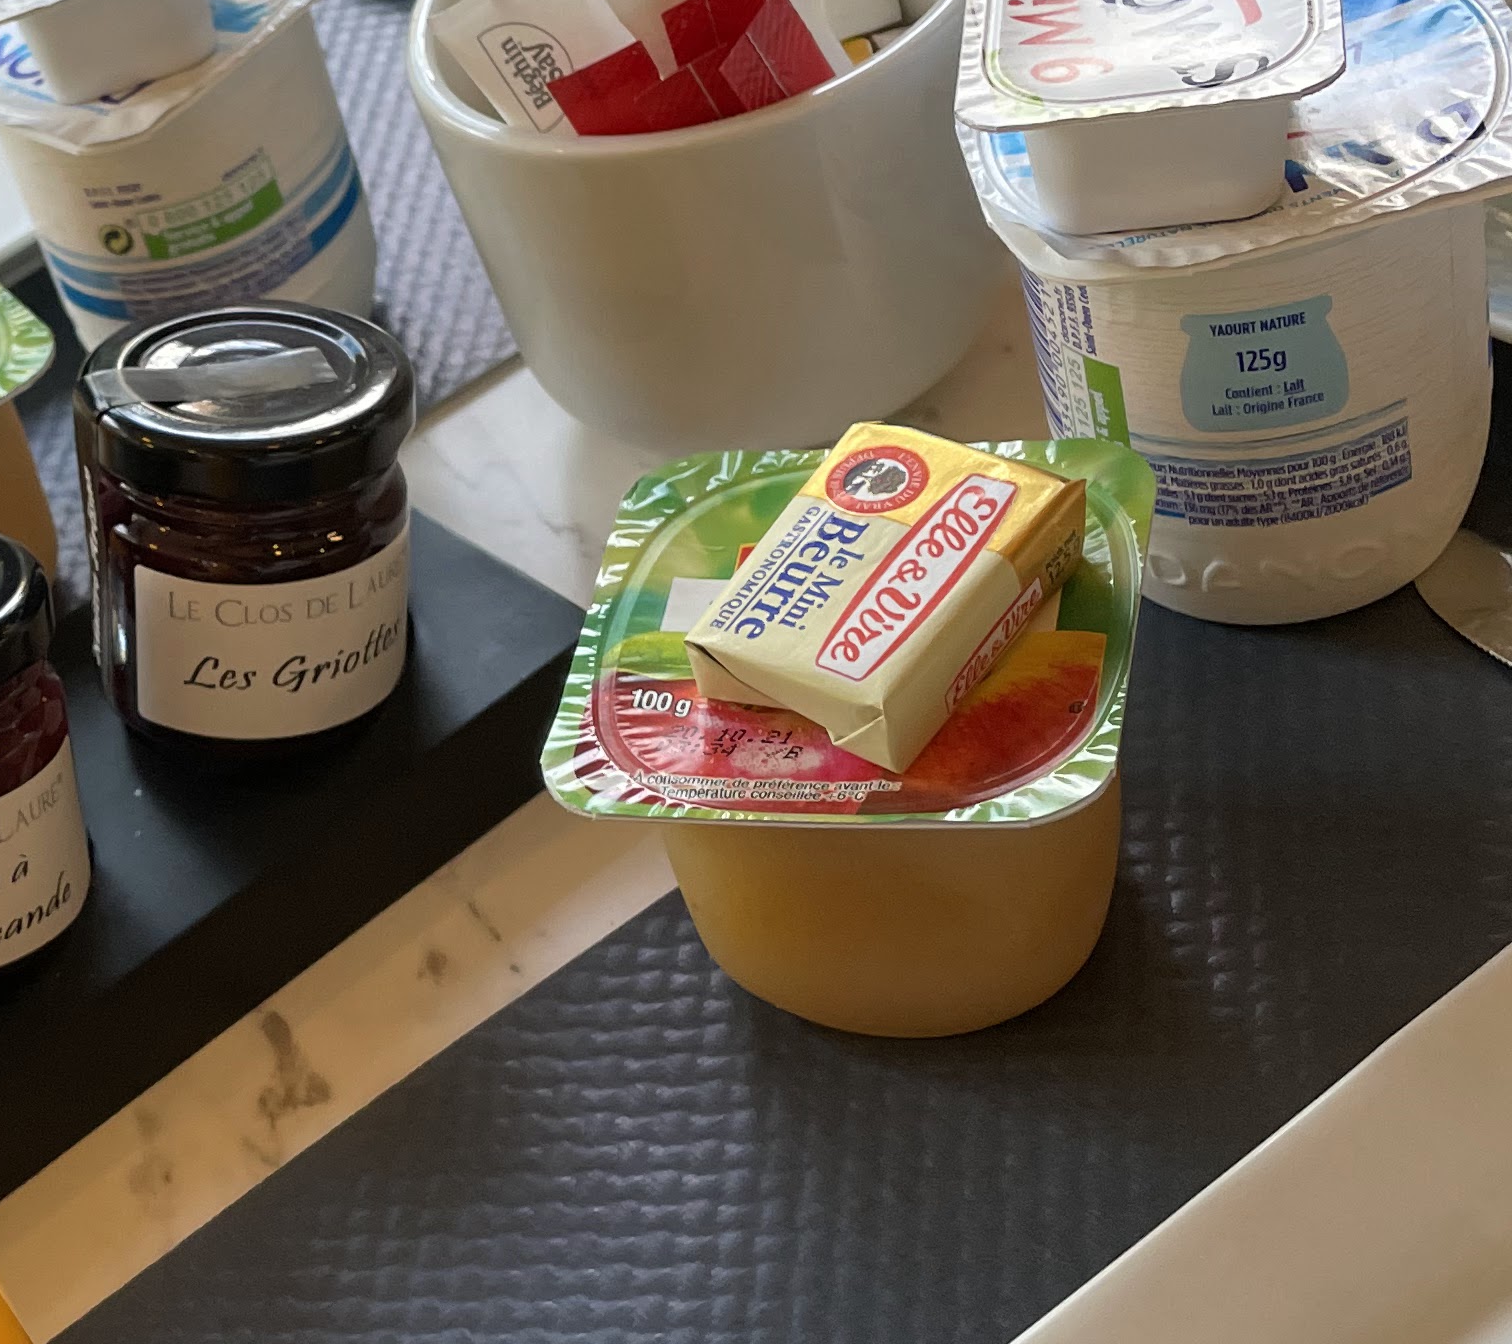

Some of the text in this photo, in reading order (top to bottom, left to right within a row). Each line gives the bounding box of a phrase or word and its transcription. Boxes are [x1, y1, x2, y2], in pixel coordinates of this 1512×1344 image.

[501, 36, 553, 109] Béghin
[1030, 56, 1113, 84] 9
[1209, 311, 1306, 337] YAOURT NATURE
[1235, 348, 1287, 373] 125g
[1212, 391, 1325, 416] Lait Origine France
[1225, 378, 1306, 400] Contient Lait
[709, 505, 822, 630] GASTRONOMIQUE
[733, 510, 870, 641] Beurre
[830, 485, 998, 663] Elle & Vire
[777, 545, 866, 632] le Mini
[169, 591, 201, 620] LE
[215, 599, 292, 627] CLOS
[184, 618, 402, 693] Les Griottes
[631, 687, 692, 718] 100 g
[647, 773, 729, 788] consommer
[733, 778, 751, 789] de
[753, 777, 831, 792] préférence
[834, 781, 872, 792] avant
[661, 785, 747, 801] Température
[826, 789, 866, 802] +6°C
[11, 853, 29, 884] à
